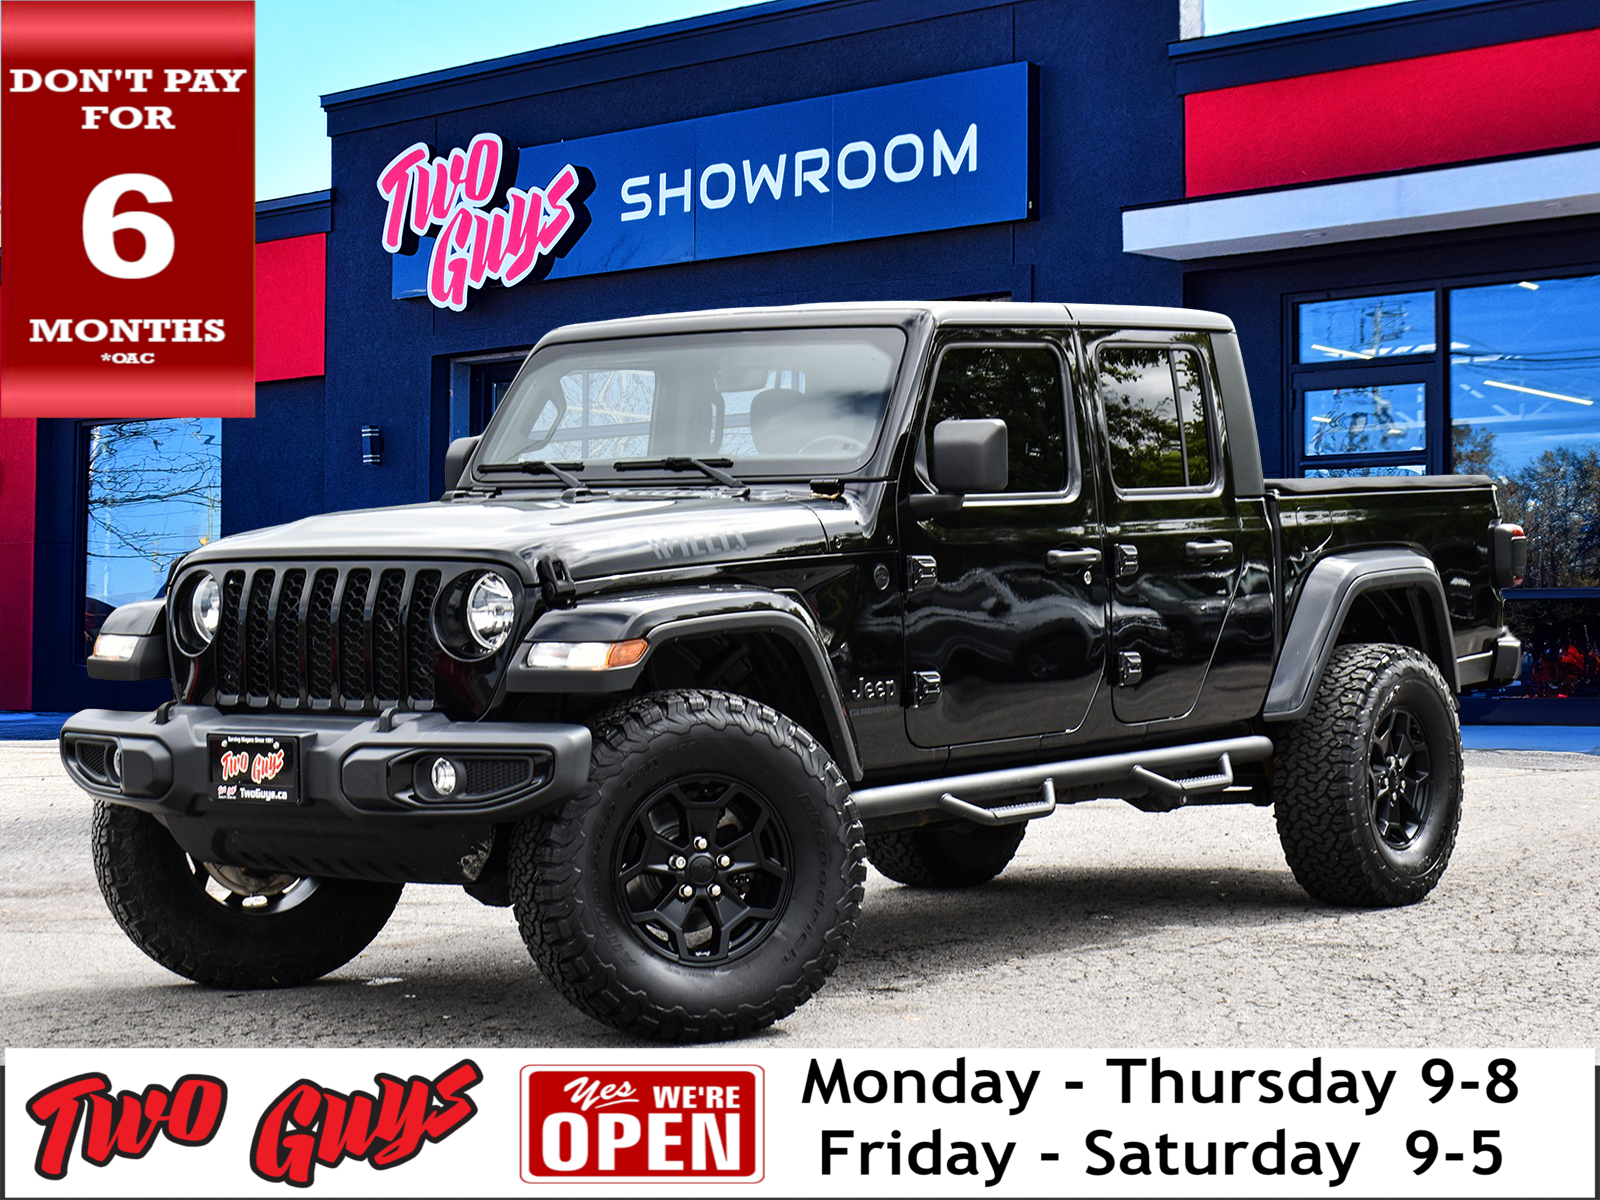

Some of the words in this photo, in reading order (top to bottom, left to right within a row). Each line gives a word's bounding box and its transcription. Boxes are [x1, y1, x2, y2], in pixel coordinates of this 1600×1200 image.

[620, 122, 978, 222] SHOWROOM
[851, 676, 897, 703] Jeep
[240, 787, 288, 801] TwoGuys.ca
